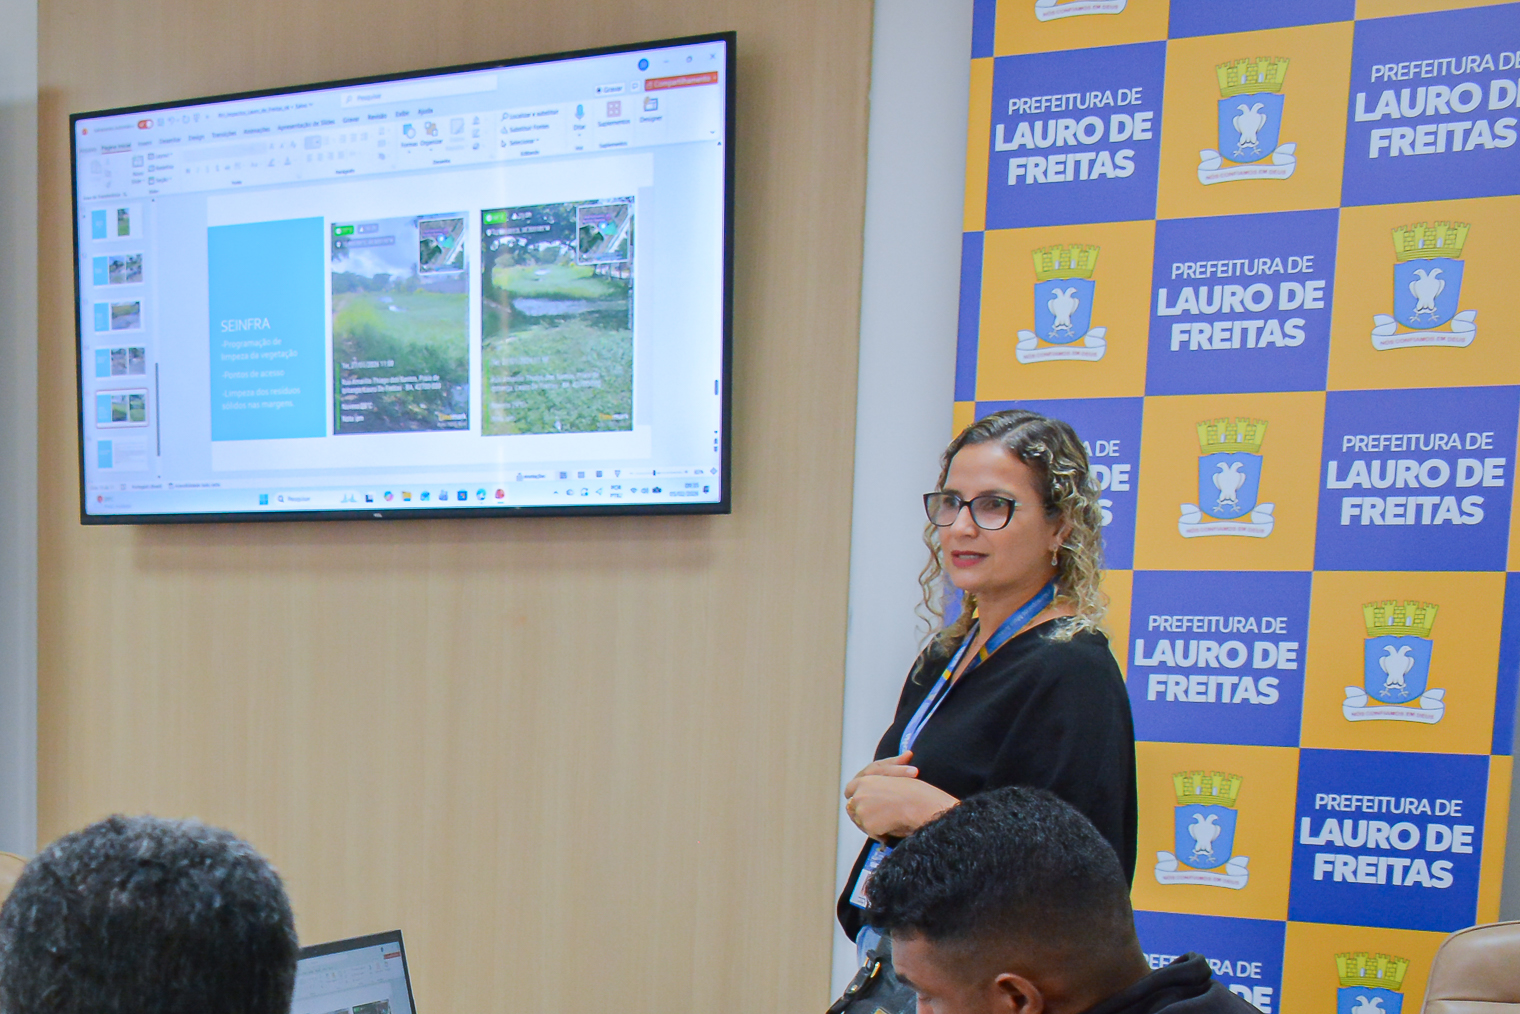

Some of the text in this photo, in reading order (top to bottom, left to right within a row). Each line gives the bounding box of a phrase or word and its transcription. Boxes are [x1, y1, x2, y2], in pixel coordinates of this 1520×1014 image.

[1371, 54, 1495, 82] PREFEITURA
[1008, 87, 1143, 115] PREFEITURA DE
[1355, 78, 1520, 122] LAURO D
[995, 111, 1154, 151] LAURO DE
[1369, 117, 1517, 158] FREITAS
[1008, 149, 1135, 185] FREITAS
[1171, 255, 1314, 279] PREFEITURA DE
[1157, 280, 1326, 316] LAURO DE
[221, 317, 271, 332] SEINFRA
[1171, 318, 1306, 351] FREITAS
[1095, 439, 1120, 457] DE
[1342, 432, 1494, 452] PREFEITURA DE
[1327, 458, 1506, 489] LAURO DE
[1341, 495, 1484, 525] FREITAS
[1148, 615, 1288, 634] PREFEITURA DE
[1134, 639, 1299, 670] LAURO DE
[1147, 674, 1279, 705] FREITAS
[1315, 793, 1463, 817] PREFEITURA DE
[1300, 817, 1475, 854] LAURO DE
[1313, 853, 1454, 889] FREITAS
[1236, 961, 1263, 979] DE
